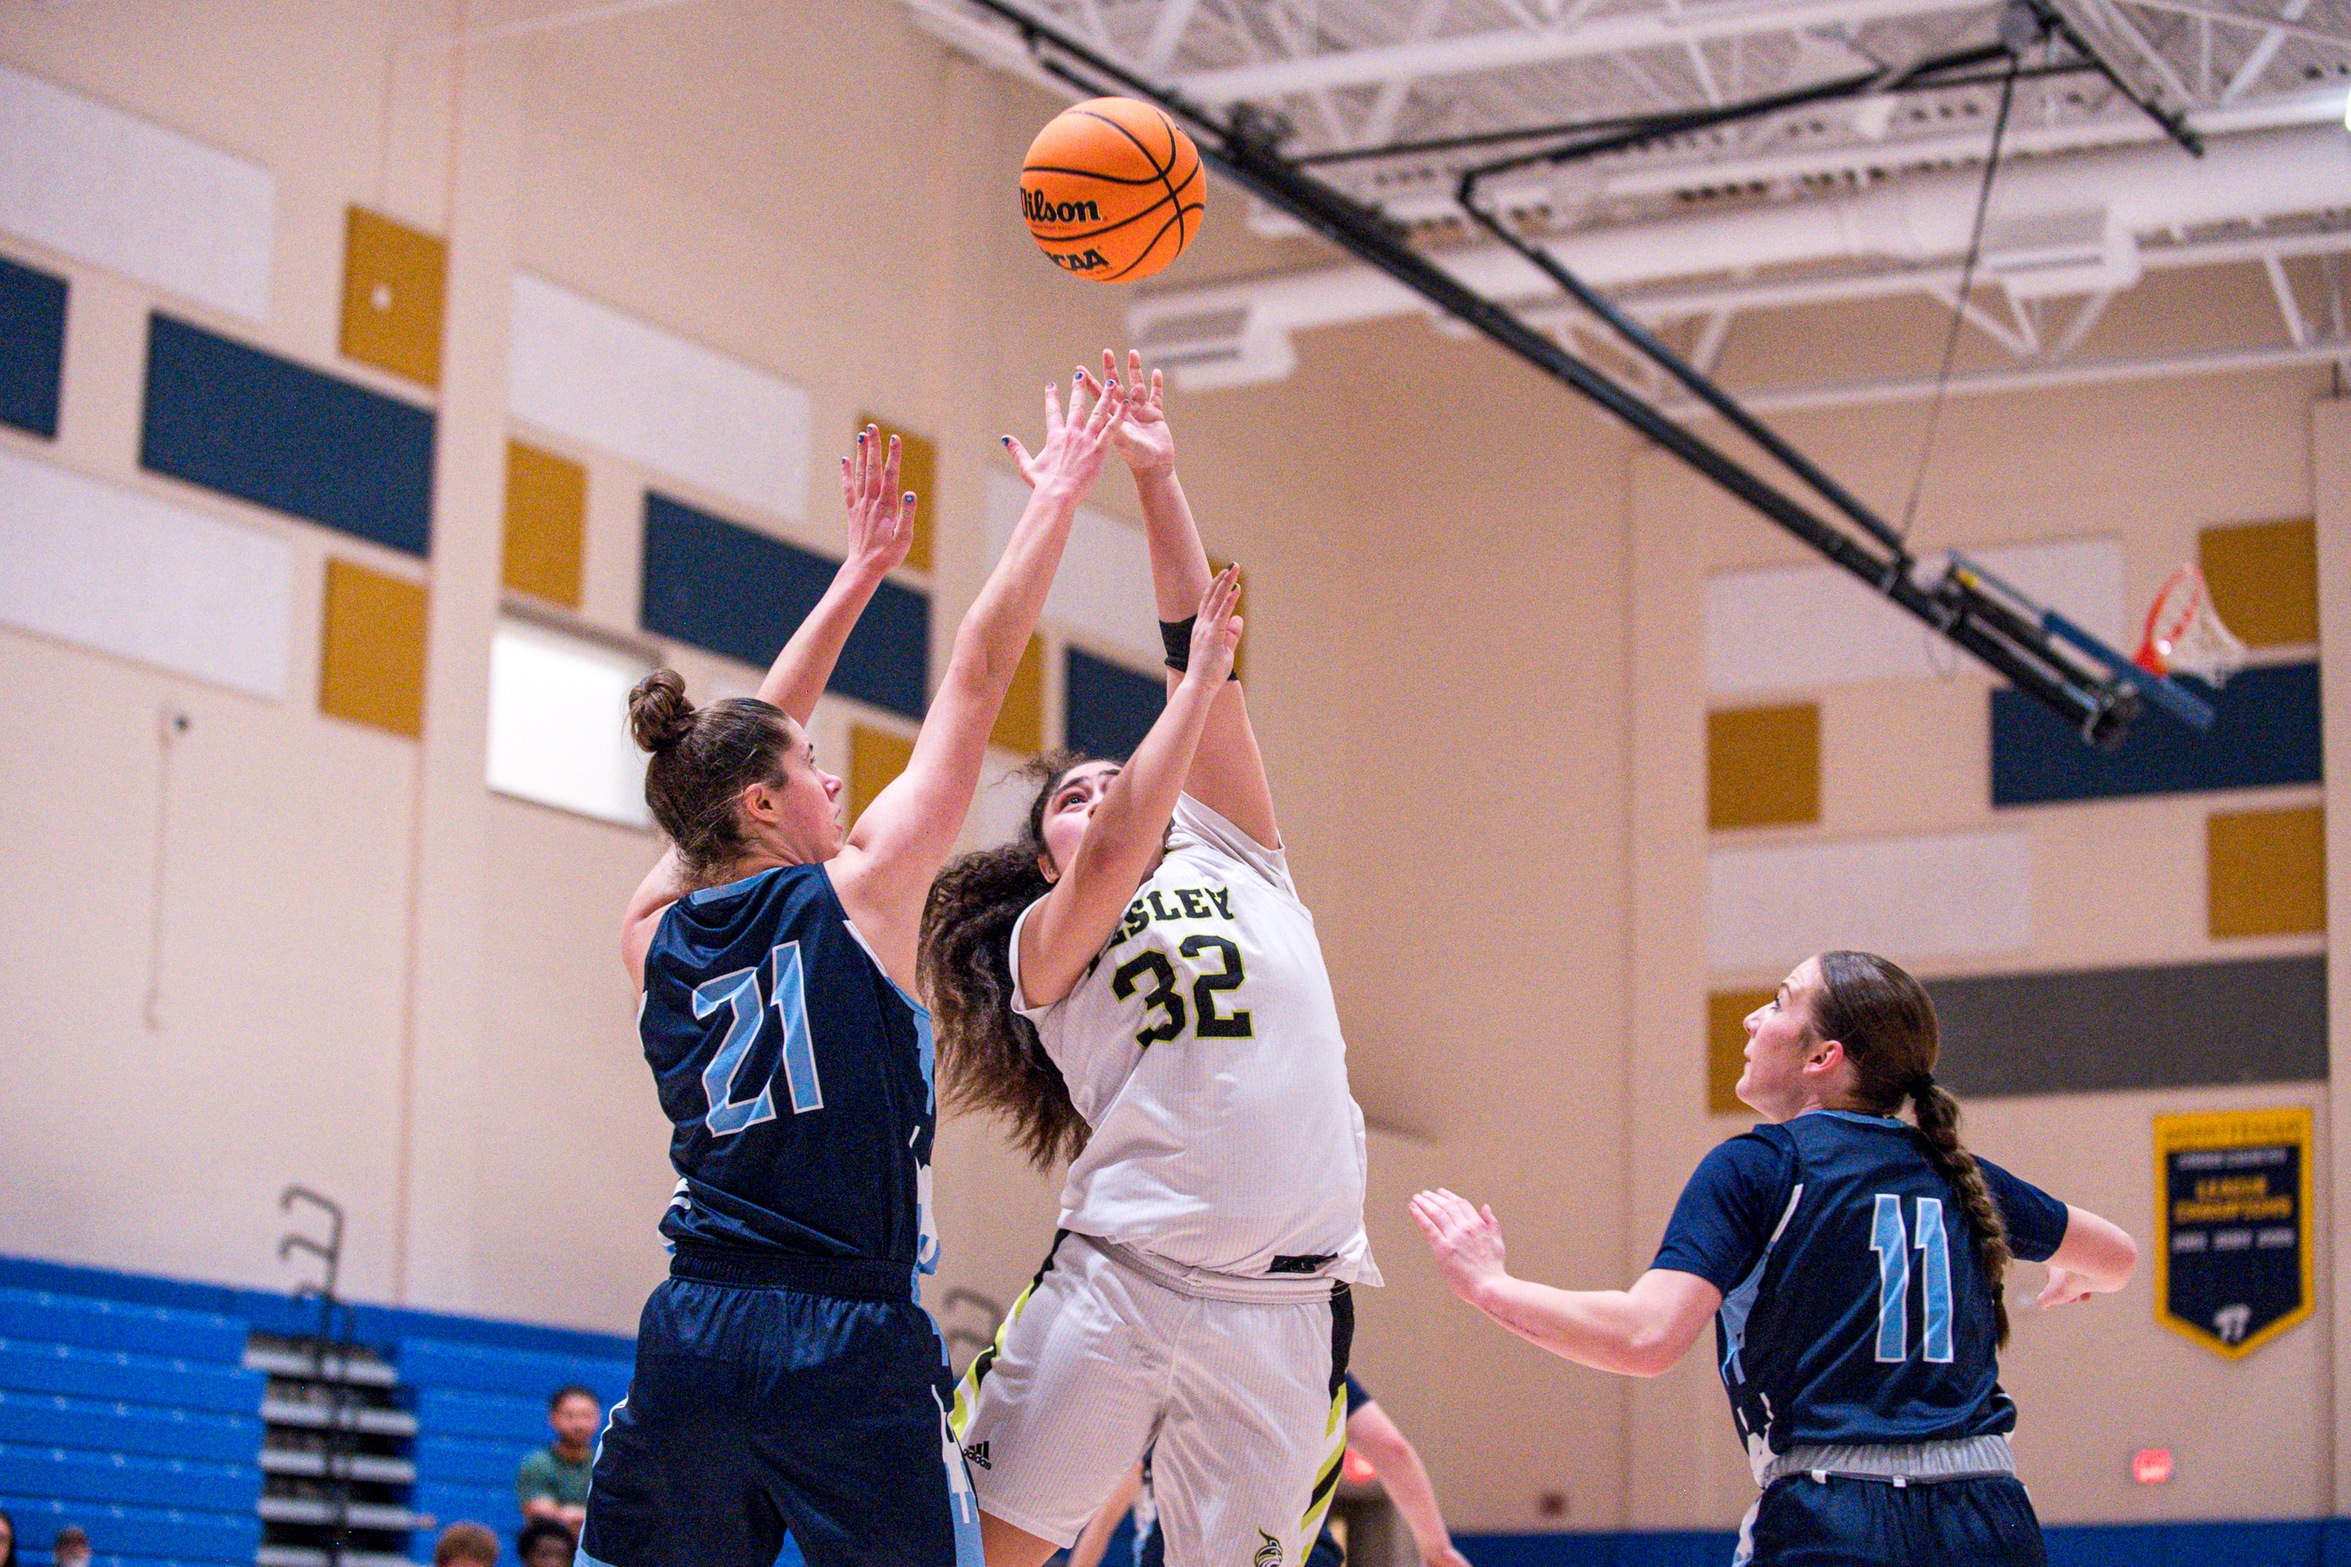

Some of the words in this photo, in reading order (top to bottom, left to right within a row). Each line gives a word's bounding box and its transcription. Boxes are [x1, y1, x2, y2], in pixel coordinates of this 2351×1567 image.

[1041, 247, 1110, 271] CAA
[1096, 886, 1236, 962] SLEY
[692, 940, 824, 1138] 21
[1111, 934, 1255, 1050] 32
[1869, 1193, 1954, 1364] 11
[962, 1448, 992, 1470] adidas
